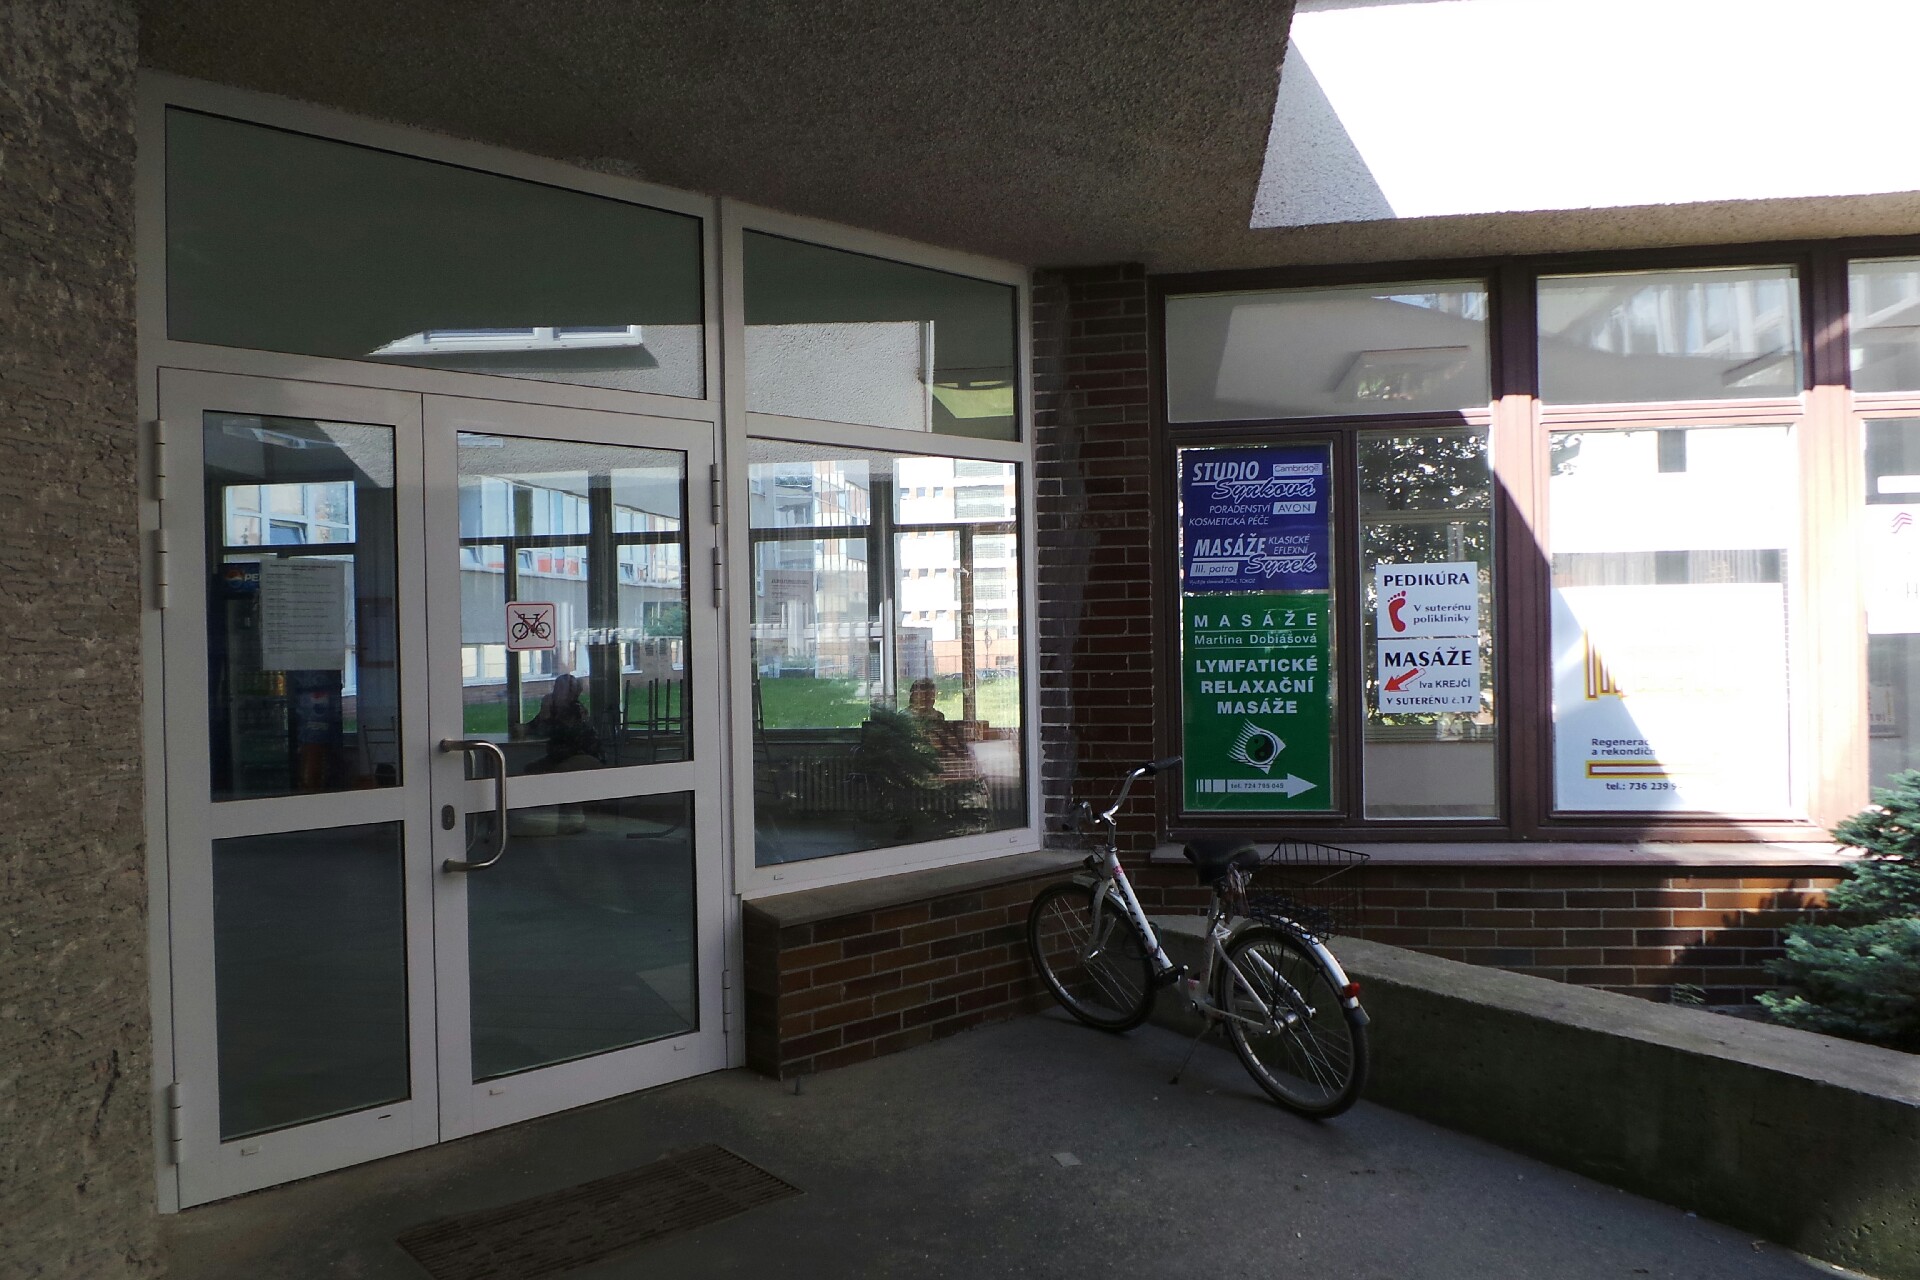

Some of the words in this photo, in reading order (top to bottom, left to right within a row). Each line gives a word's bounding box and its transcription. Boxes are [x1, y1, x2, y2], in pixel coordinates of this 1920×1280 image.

[1192, 460, 1260, 481] STUDIO
[1212, 477, 1317, 504] Synková
[1209, 503, 1271, 514] PORADENSTVÍ
[1277, 503, 1311, 513] AVON
[1189, 515, 1246, 526] KOSMETICKÁ
[1247, 514, 1269, 525] PÉČE
[1193, 532, 1267, 557] MASÁŽE
[1268, 534, 1311, 545] KLASICKÉ
[1208, 565, 1234, 575] patro
[1245, 552, 1317, 578] Synek
[244, 573, 262, 582] PE
[1383, 571, 1470, 587] PEDIKÚRA
[1413, 604, 1422, 612] V
[1424, 603, 1472, 612] suterénu
[1194, 610, 1318, 627] MASÁŽE
[1413, 613, 1471, 626] polikliniky
[1194, 634, 1243, 645] Martina
[1249, 632, 1318, 645] Dobiášová
[1384, 646, 1473, 667] MASÁŽE
[1195, 655, 1318, 674] LYMFATICKÉ
[1200, 676, 1315, 694] RELAXAČNÍ
[1419, 680, 1433, 689] Iva
[1435, 678, 1471, 689] KREJČÍ
[1386, 697, 1394, 706] V
[1396, 693, 1449, 706] SUTERÉNU
[1217, 698, 1298, 715] MASÁŽE
[1591, 748, 1598, 756] a
[1606, 782, 1626, 791] tel.:
[1629, 782, 1647, 791] 736
[1651, 782, 1669, 791] 239
